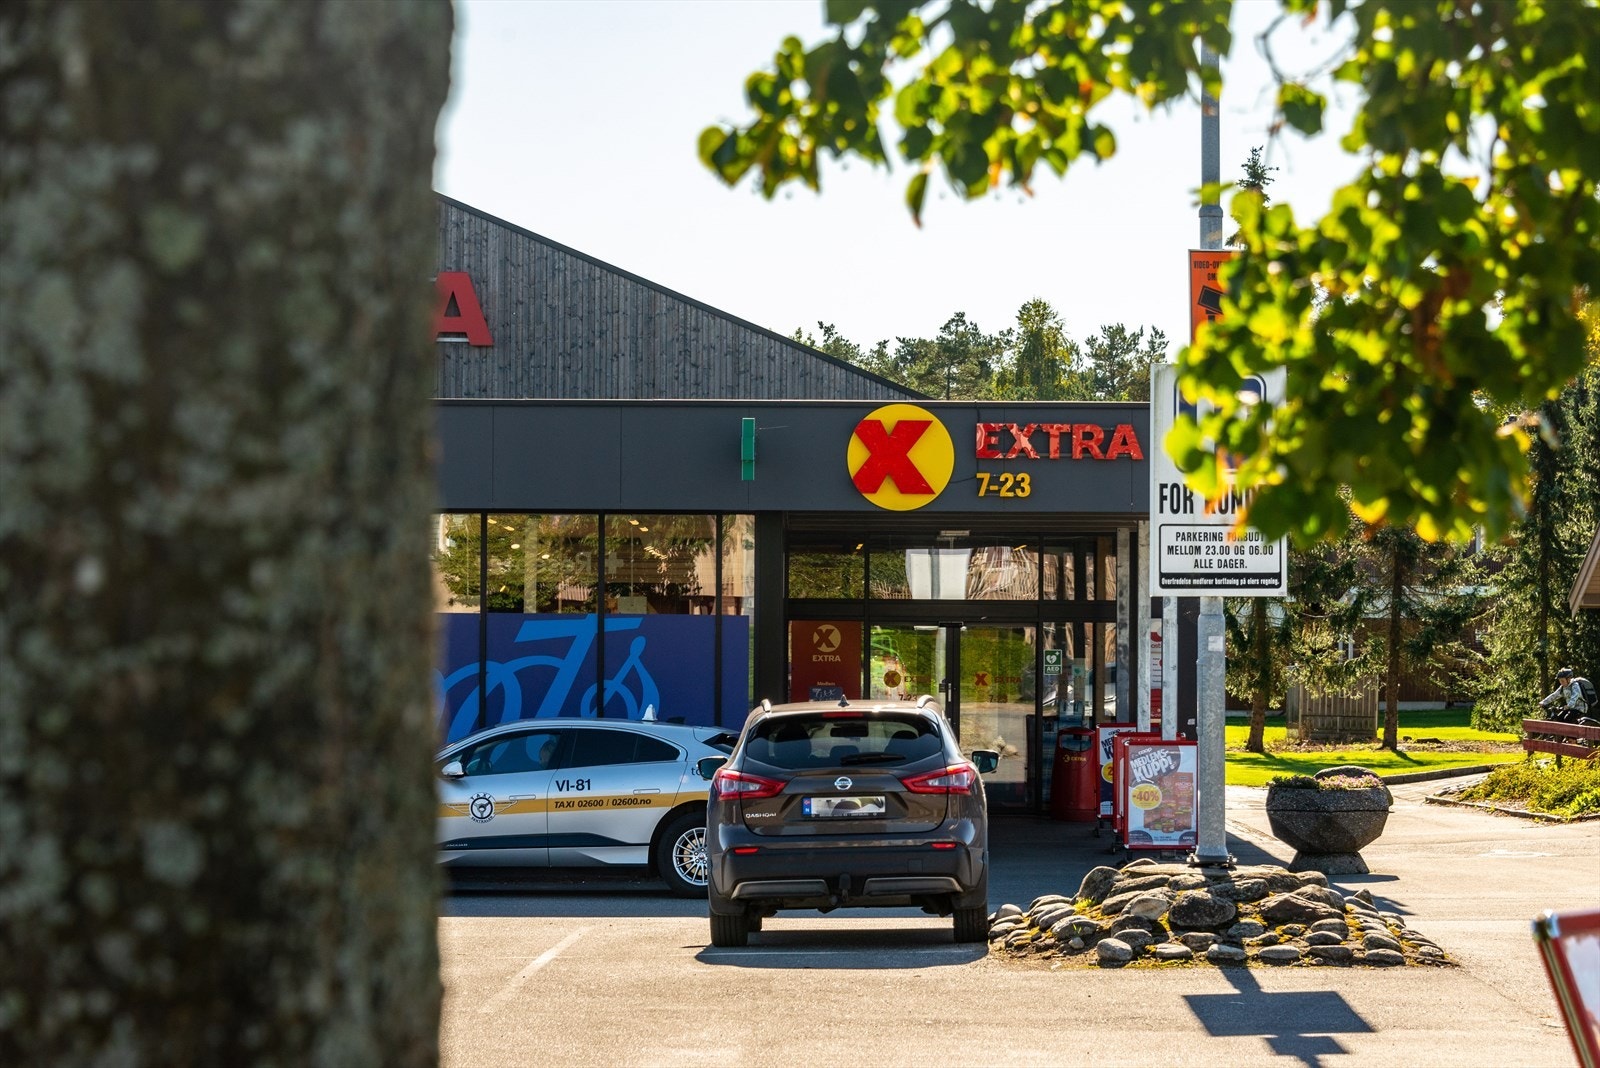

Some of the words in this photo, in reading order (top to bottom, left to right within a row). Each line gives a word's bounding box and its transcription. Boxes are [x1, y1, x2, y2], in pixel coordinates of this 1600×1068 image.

[1193, 260, 1222, 269] VIDEO-OV
[976, 423, 1144, 460] EXTRA
[976, 472, 1031, 497] 7-23
[1159, 483, 1194, 514] FOR
[1176, 532, 1223, 542] PARKERING
[1167, 545, 1201, 555] MELLOM
[1205, 545, 1230, 555] 23.00
[1234, 545, 1245, 555] OG
[1249, 545, 1274, 555] 06.00
[1194, 559, 1213, 569] ALLE
[1217, 559, 1248, 569] DAGER.
[812, 654, 841, 662] EXTRA
[1132, 755, 1175, 783] KUPP!
[555, 779, 592, 792] VI-81
[1132, 790, 1160, 802] -40%
[577, 799, 604, 808] 02600
[611, 798, 652, 806] 02600.no
